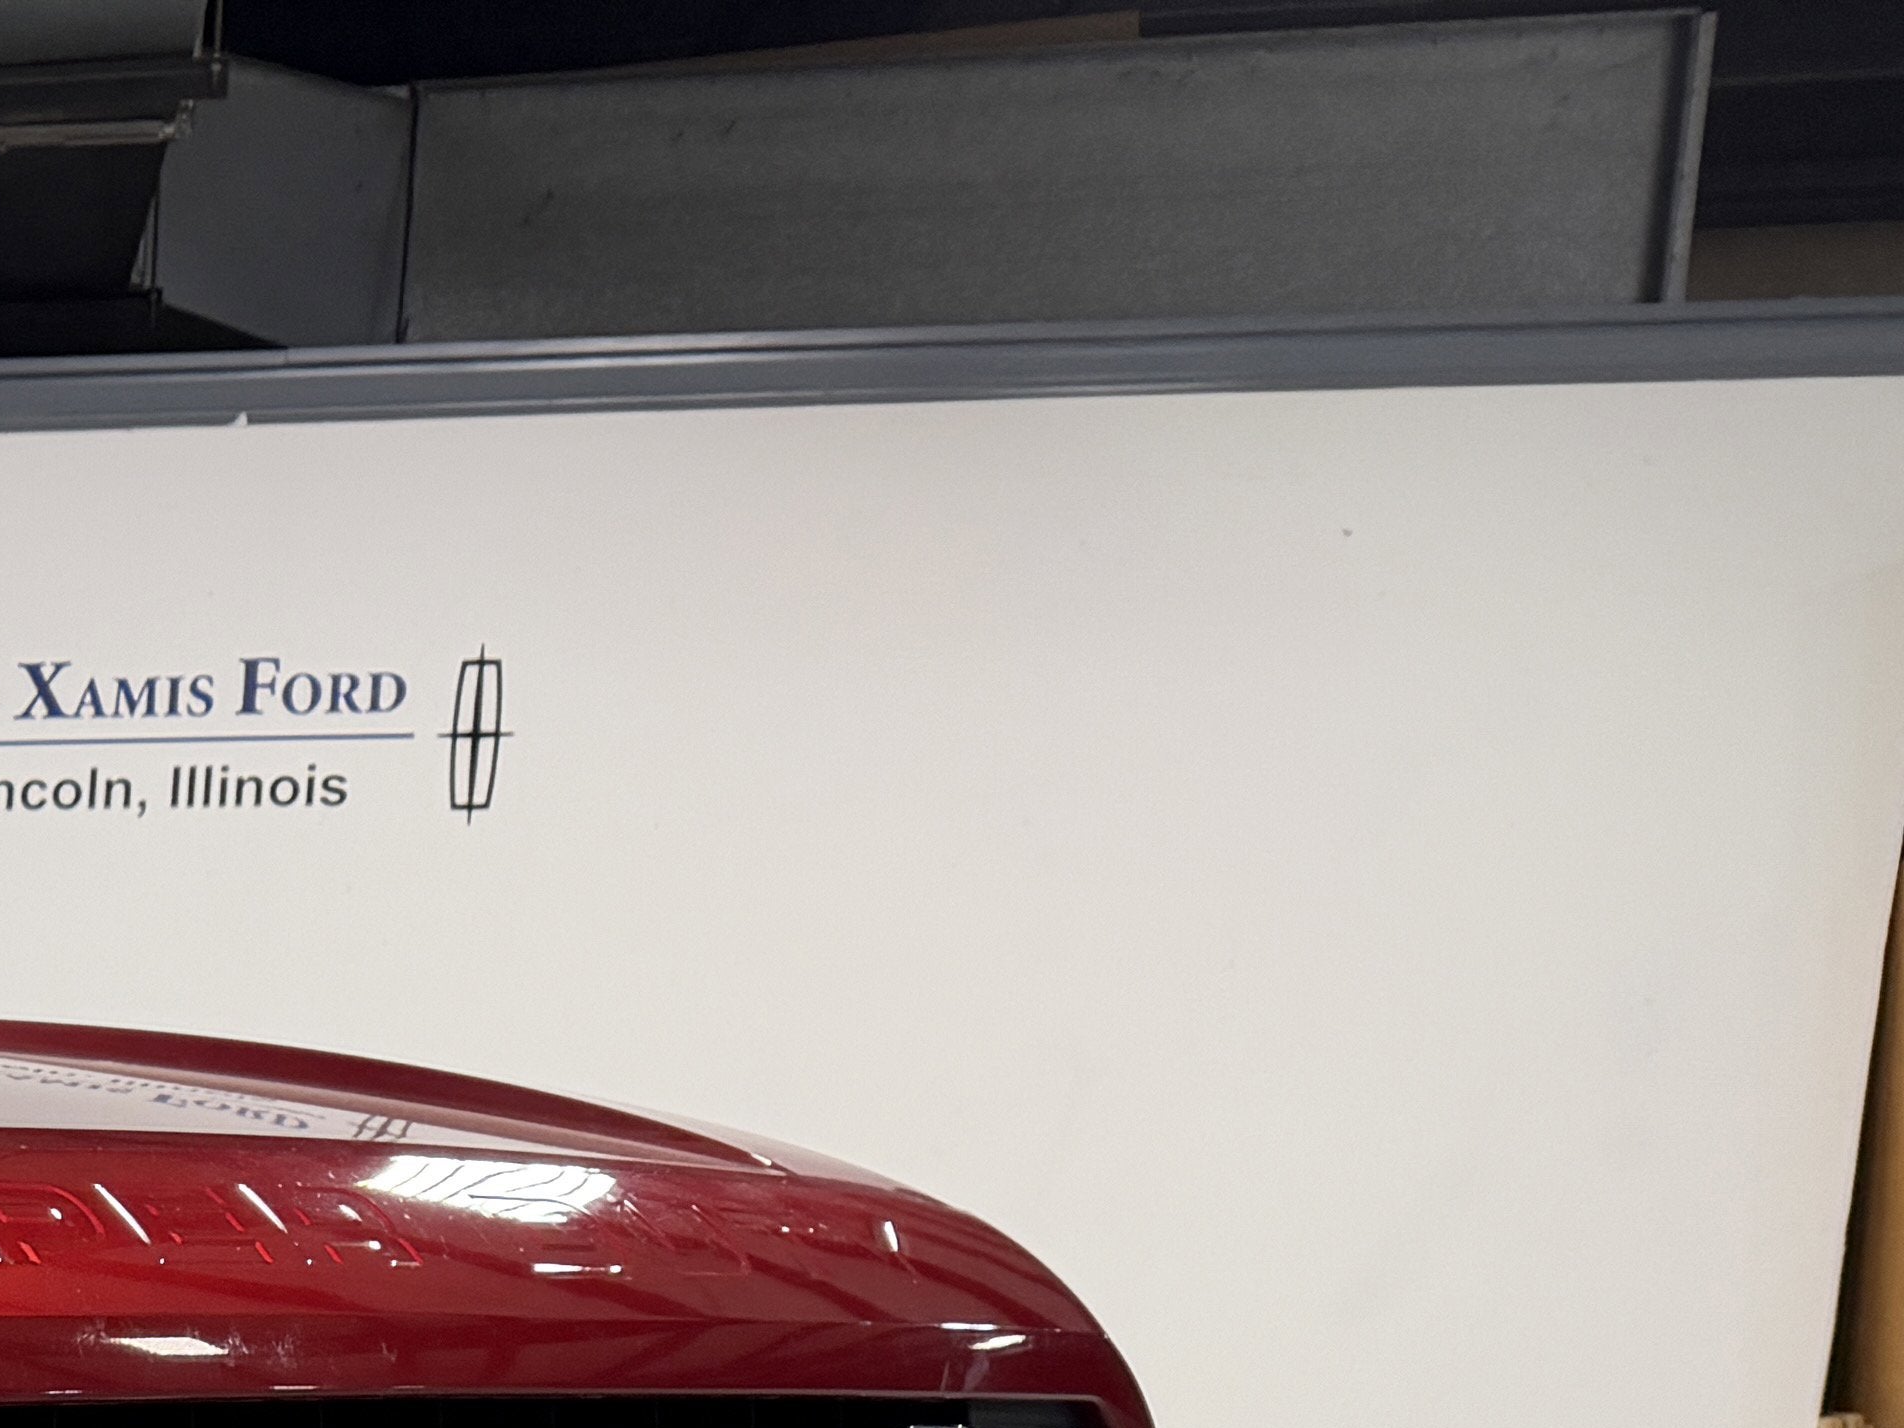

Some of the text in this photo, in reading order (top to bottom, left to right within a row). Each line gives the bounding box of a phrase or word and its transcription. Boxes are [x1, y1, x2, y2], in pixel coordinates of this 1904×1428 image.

[14, 660, 216, 721] XAMIS
[237, 657, 408, 716] FORD
[170, 764, 349, 810] Illinois
